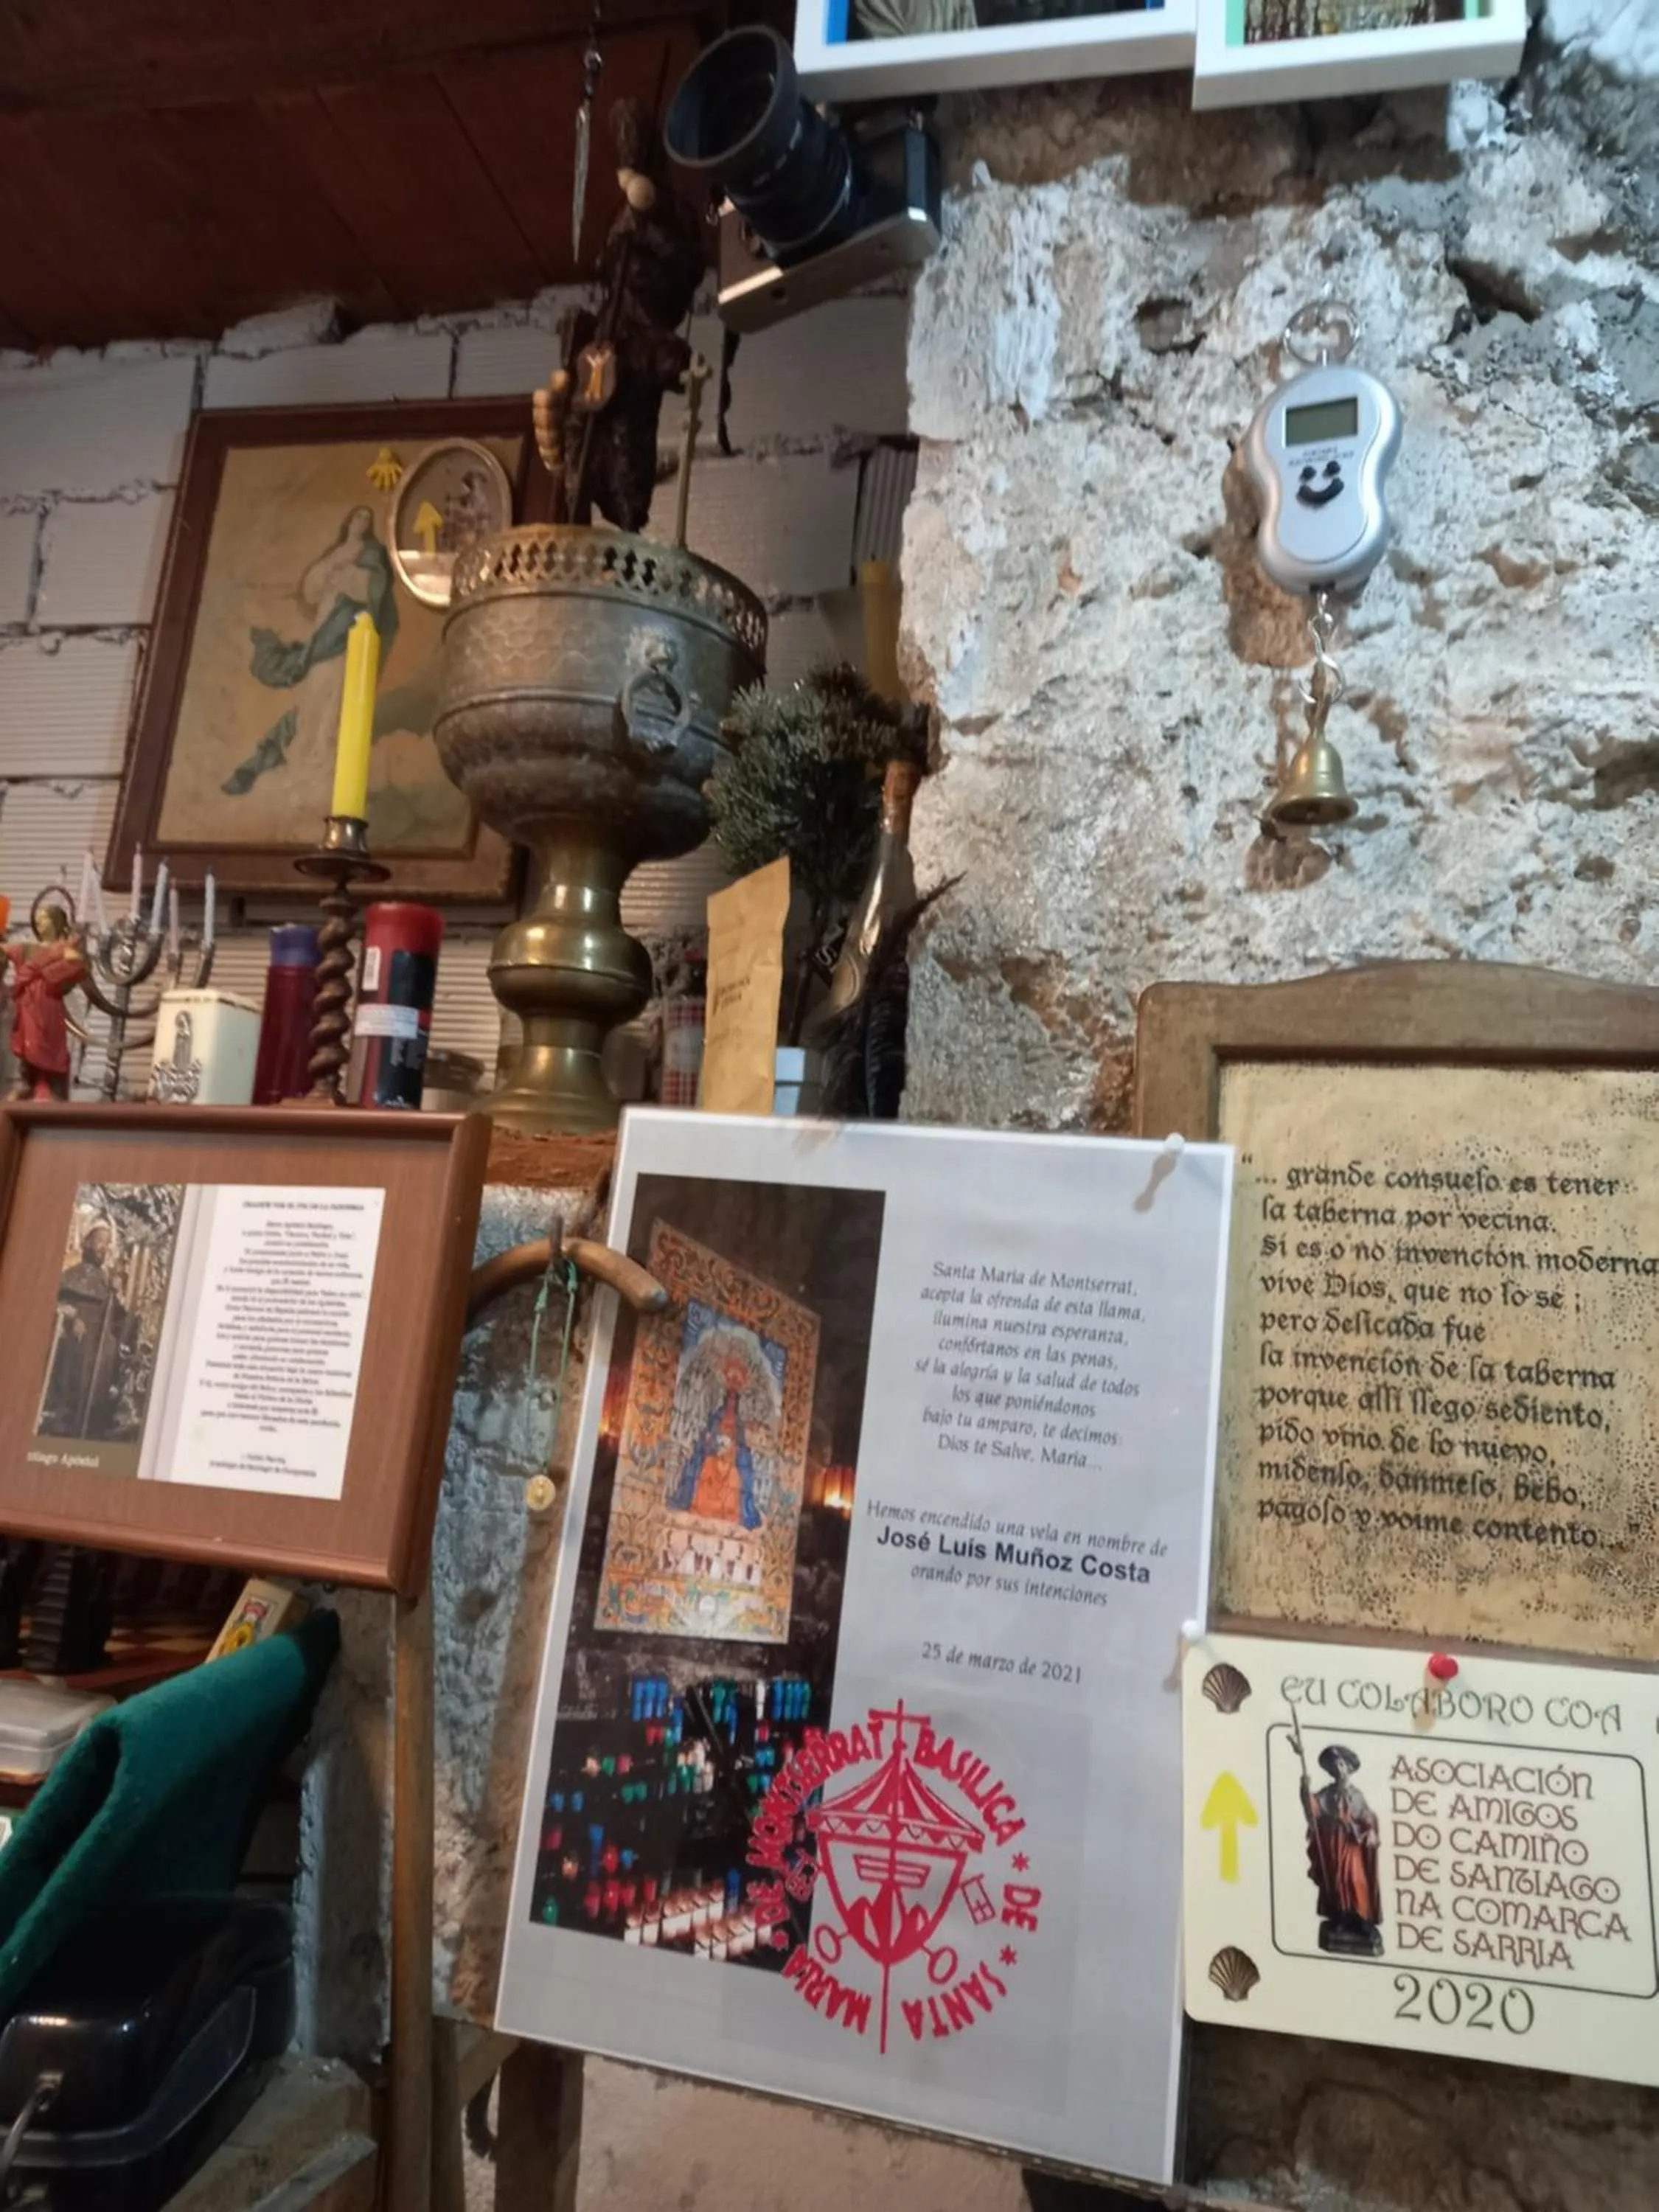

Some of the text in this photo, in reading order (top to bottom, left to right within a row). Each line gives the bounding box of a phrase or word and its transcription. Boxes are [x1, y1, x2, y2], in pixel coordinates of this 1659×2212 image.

[1286, 1160, 1376, 1190] grande
[1385, 1165, 1500, 1193] consuelo
[1511, 1175, 1537, 1194] es
[1545, 1172, 1620, 1196] tener
[1262, 1194, 1285, 1221] la
[1293, 1197, 1396, 1225] taberna
[1405, 1210, 1452, 1232] por
[1260, 1232, 1287, 1258] Si
[1296, 1240, 1322, 1258] es
[1329, 1242, 1346, 1260] o
[1354, 1239, 1385, 1262] no
[932, 1262, 975, 1281] Santa
[1029, 1270, 1046, 1287] de
[1050, 1271, 1137, 1297] Montserrat,
[1260, 1269, 1315, 1296] vive
[1324, 1268, 1397, 1304] Dios,
[1404, 1281, 1450, 1307] que
[1460, 1285, 1492, 1304] no
[1501, 1280, 1529, 1307] lo
[920, 1286, 1145, 1323] acepta la ofrenda de esta llama,
[933, 1310, 1128, 1346] ilumina nuestra esperanza,
[1260, 1307, 1486, 1348] pero delicada fue
[939, 1335, 1119, 1371] confórtanos en las penas,
[1260, 1340, 1615, 1390] la invención de la taberna
[915, 1357, 1141, 1397] sé la alegría y la salud de todos
[922, 1405, 953, 1426] bajo
[957, 1411, 972, 1427] tu
[977, 1417, 1037, 1438] amparo,
[1043, 1423, 1056, 1439] te
[952, 1385, 1096, 1418] los que poniéndonos
[1259, 1384, 1349, 1413] porque
[1412, 1385, 1475, 1423] llego
[1485, 1394, 1610, 1433] sediento,
[937, 1433, 969, 1453] Dios
[974, 1439, 988, 1455] te
[1259, 1417, 1314, 1446] pido
[1390, 1425, 1419, 1454] de
[1430, 1427, 1453, 1455] lo
[1462, 1439, 1556, 1468] nuevo,
[1514, 1472, 1585, 1510] bebo,
[866, 1499, 1167, 1557] Hemos encendido una vela en nombre de
[1357, 1509, 1371, 1532] y
[877, 1526, 1152, 1584] José Luís Muñoz Costa
[911, 1564, 1108, 1607] orando por sus intenciones
[922, 1641, 1082, 1684] 25 de marzo de 2021
[1337, 1679, 1534, 1727] COLABORO
[1389, 1755, 1593, 1801] ASOCIACIÓN
[1390, 1788, 1579, 1832] DE AMIGOS
[1392, 1821, 1589, 1866] DO CAMIÑO
[745, 1719, 1041, 2041] BASILICA DE SANTA MARIA DE MONTSERRAT
[1394, 1854, 1621, 1905] DE SANTIAGO
[1395, 1888, 1632, 1941] NA COMARCA
[1397, 1921, 1574, 1970] DE SARRIA
[1394, 1972, 1535, 2035] 2020
